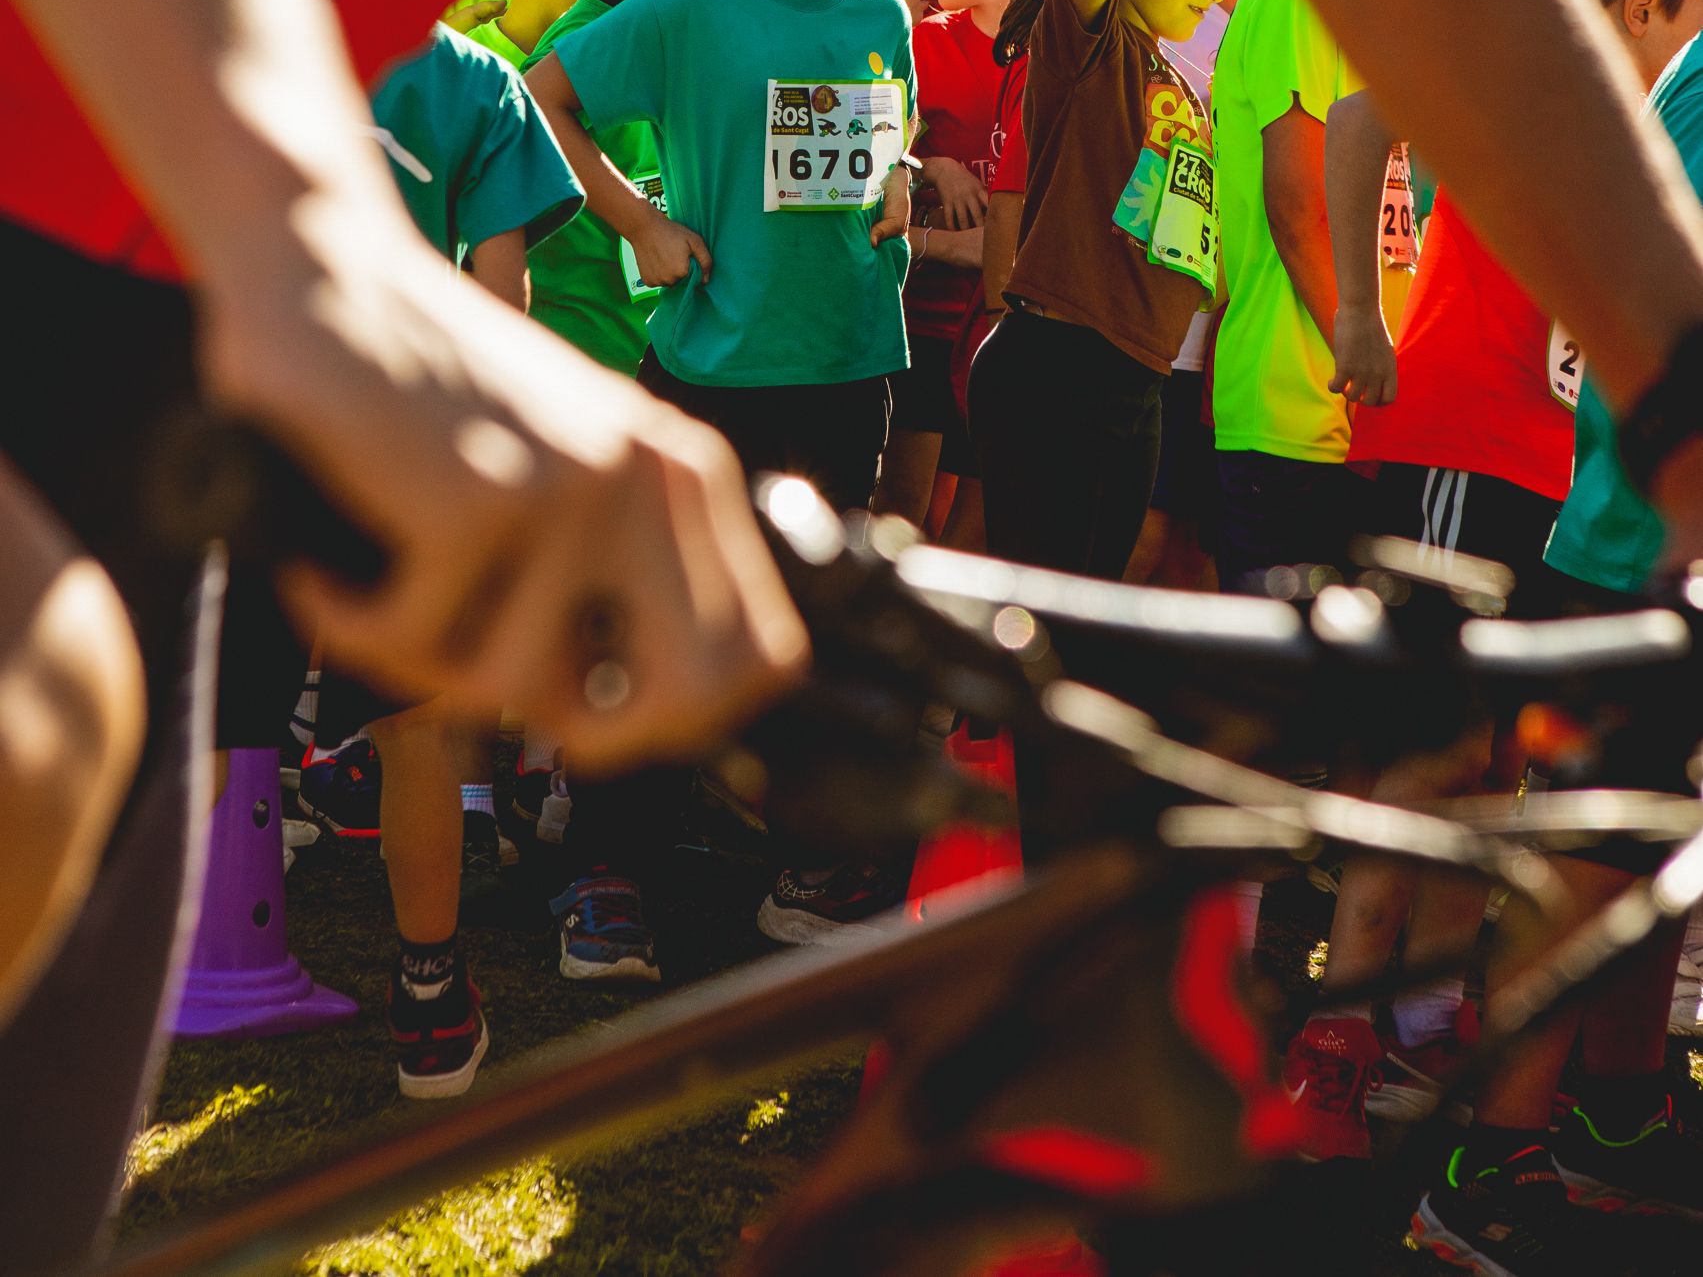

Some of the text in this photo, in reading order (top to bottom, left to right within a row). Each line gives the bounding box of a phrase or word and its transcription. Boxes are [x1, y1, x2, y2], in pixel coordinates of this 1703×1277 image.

[771, 106, 809, 127] ROS
[1388, 160, 1405, 179] ROS
[1174, 168, 1211, 203] CROS
